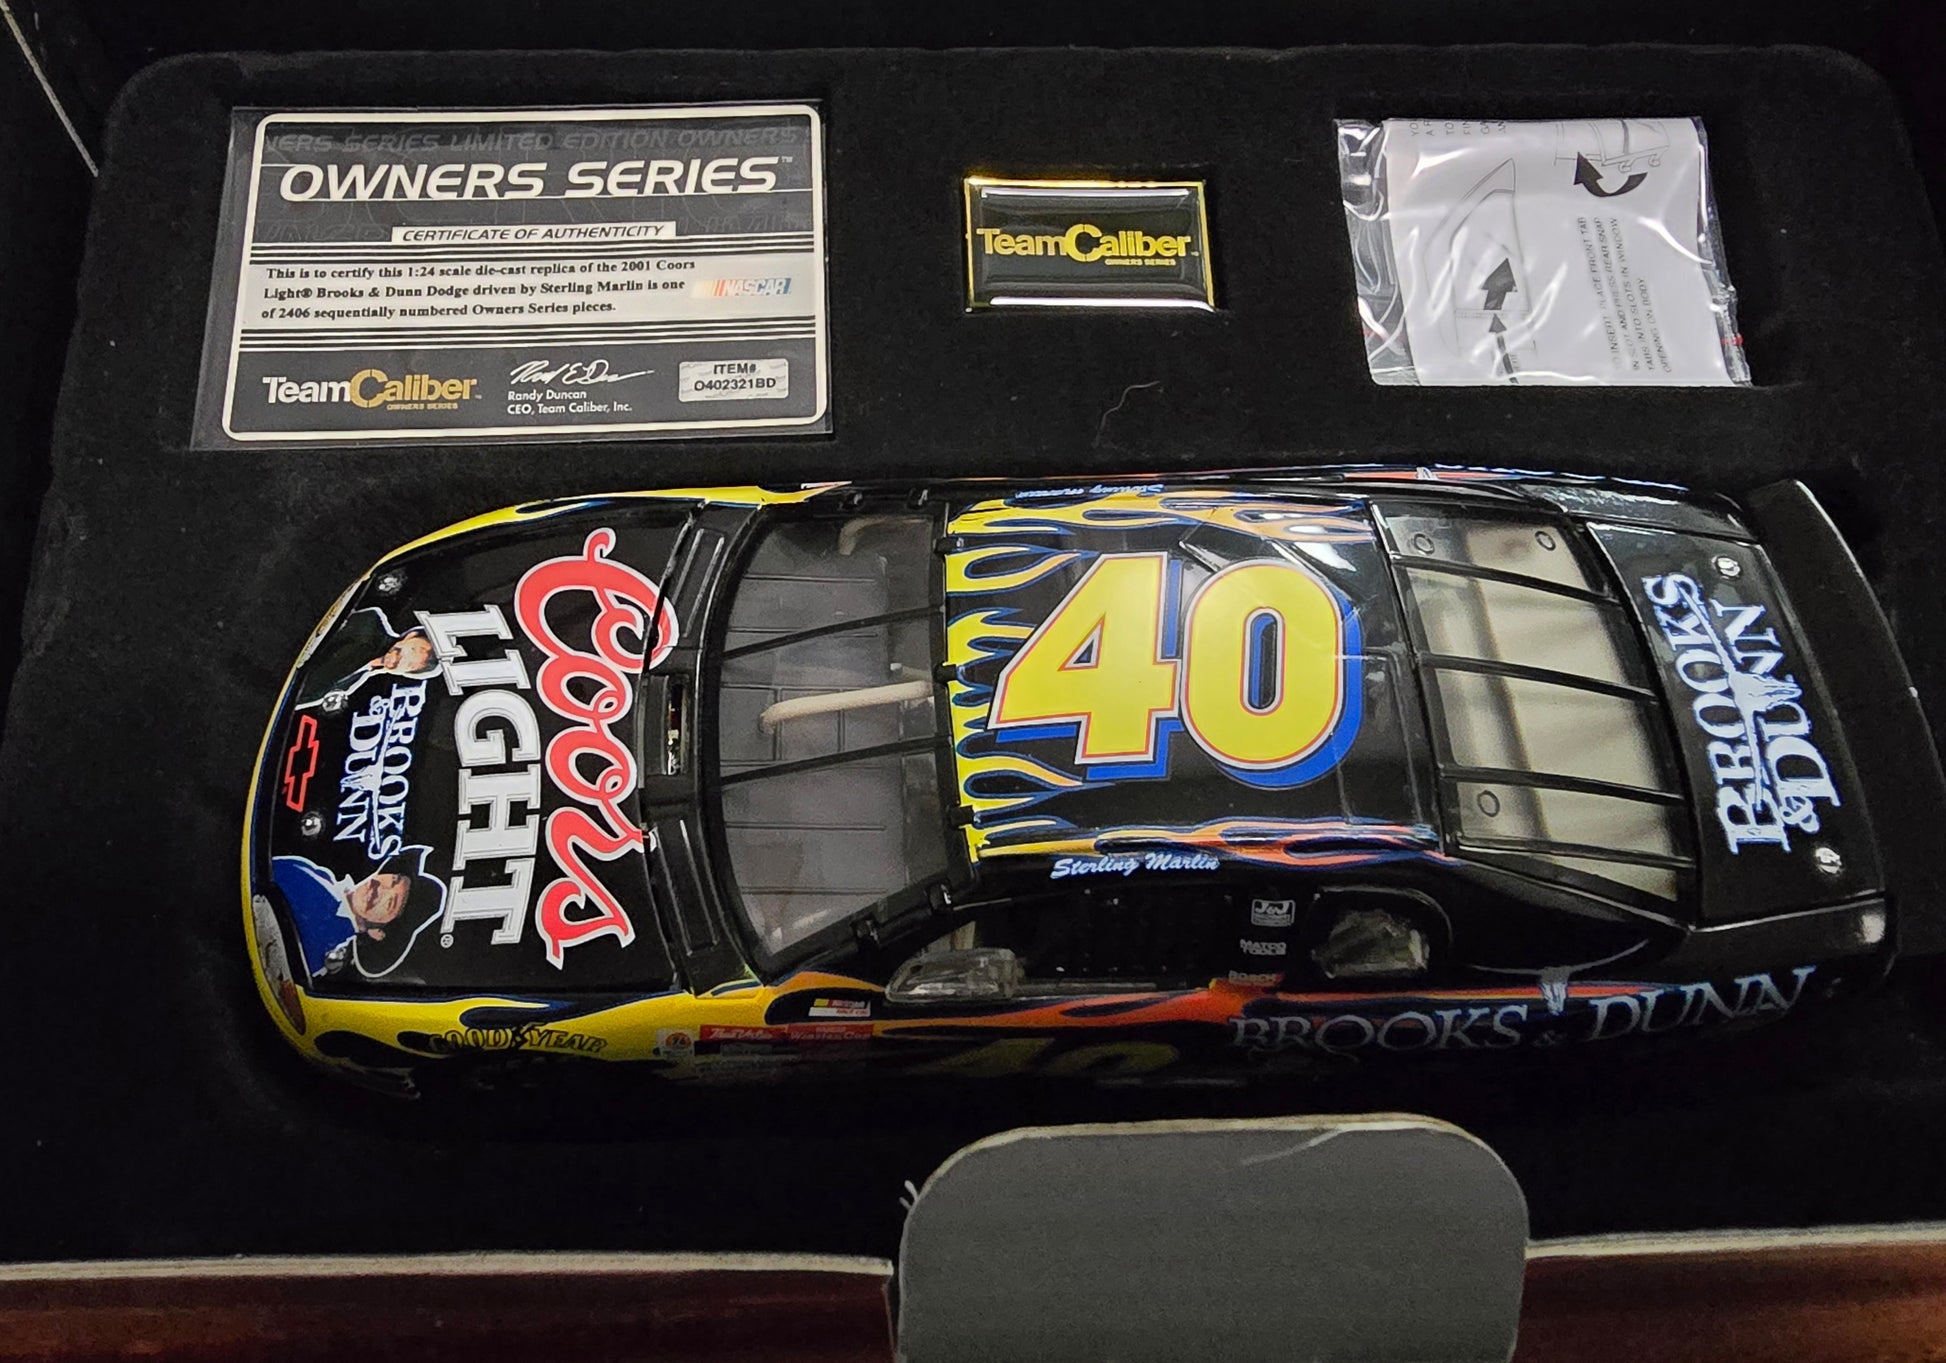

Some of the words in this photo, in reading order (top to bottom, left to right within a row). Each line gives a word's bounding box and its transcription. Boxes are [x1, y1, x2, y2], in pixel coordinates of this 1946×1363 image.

[279, 162, 547, 202] OWNERS
[564, 156, 779, 198] SERIES
[402, 229, 511, 242] CERTIFICATE
[514, 228, 539, 240] OF
[541, 225, 664, 240] AUTHENTICITY
[1610, 217, 1627, 264] WINDOW
[266, 268, 295, 278] This
[300, 268, 310, 278] is
[314, 268, 327, 278] to
[331, 266, 374, 280] certify
[378, 266, 403, 278] this
[408, 266, 435, 277] 1:24
[439, 265, 472, 276] scale
[475, 264, 526, 276] die-cast
[530, 262, 576, 277] replica
[580, 262, 595, 274] of
[597, 261, 618, 272] the
[621, 260, 651, 272] 2001
[656, 259, 696, 271] Coors
[1582, 238, 1598, 273] FRONT
[1600, 244, 1614, 273] REAR
[317, 286, 364, 298] Brooks
[368, 286, 380, 298] &
[385, 286, 422, 298] Dunn
[427, 284, 470, 300] Dodge
[473, 284, 516, 296] driven
[520, 283, 537, 297] by
[540, 282, 594, 296] Sterling
[597, 280, 644, 292] Marlin
[648, 280, 658, 290] is
[662, 281, 686, 290] one
[1623, 280, 1639, 314] SLOTS
[261, 308, 276, 319] of
[278, 307, 311, 318] 2406
[314, 305, 396, 321] sequentially
[400, 304, 468, 316] numbered
[472, 304, 525, 315] Owners
[528, 302, 568, 314] Series
[572, 302, 616, 315] pieces.
[1617, 309, 1628, 331] AND
[1632, 316, 1647, 344] INTO
[1650, 326, 1672, 374] OPENING
[713, 362, 757, 375] ITEM#
[507, 403, 535, 416] CEO,
[538, 402, 566, 414] Team
[569, 401, 611, 415] Caliber,
[613, 401, 633, 412] Inc.
[508, 390, 543, 401] Randy
[546, 389, 587, 400] Duncan
[987, 550, 1358, 785] 40
[1641, 572, 1791, 855] BROOKS
[514, 527, 681, 970] Coors
[368, 680, 427, 860] BROOKS
[1050, 853, 1139, 880] Sterling
[1144, 850, 1221, 871] Marlin
[1228, 1003, 1528, 1052] BROOKS
[1588, 965, 1817, 1041] DUNN
